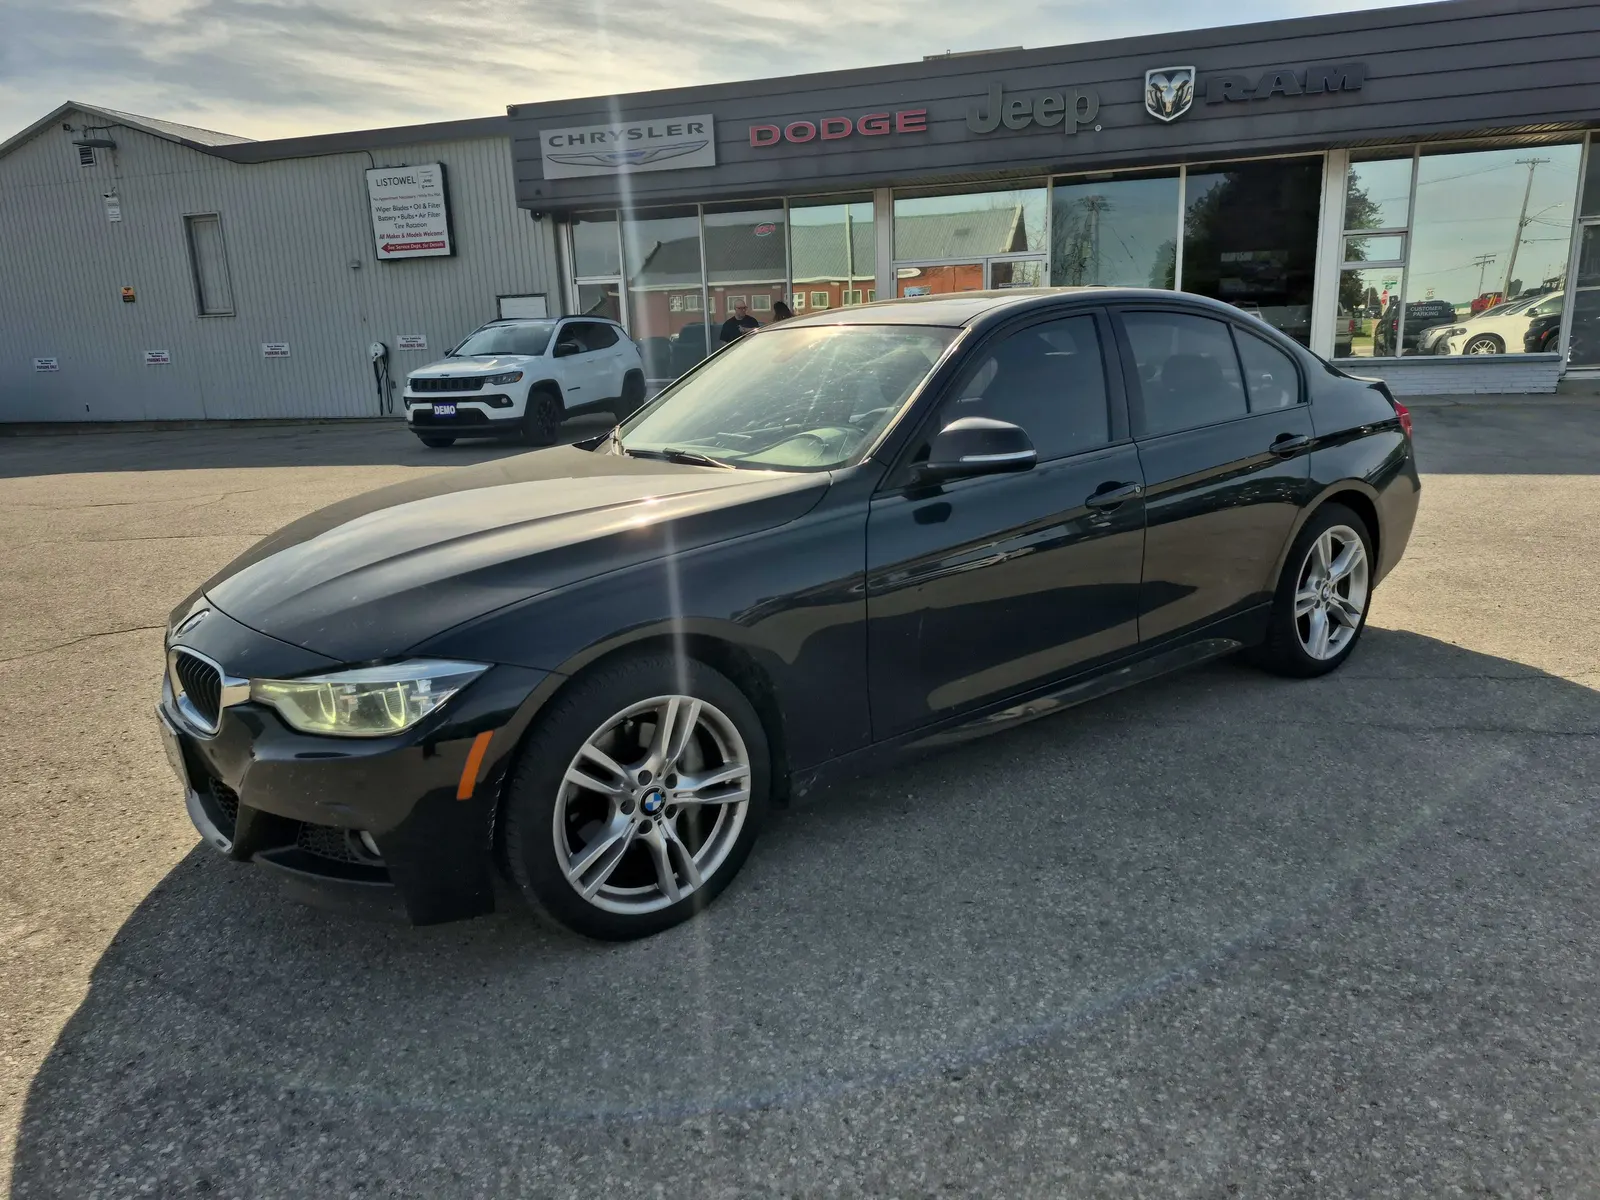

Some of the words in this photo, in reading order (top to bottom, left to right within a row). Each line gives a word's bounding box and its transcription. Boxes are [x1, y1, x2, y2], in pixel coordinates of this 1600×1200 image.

[1205, 63, 1365, 105] RAM
[966, 82, 1100, 134] Jeep
[548, 122, 705, 147] CHRYSLER
[750, 108, 927, 147] DODGE
[375, 176, 417, 187] LISTOWEL
[378, 214, 397, 222] Battery
[434, 405, 456, 415] DEMO
